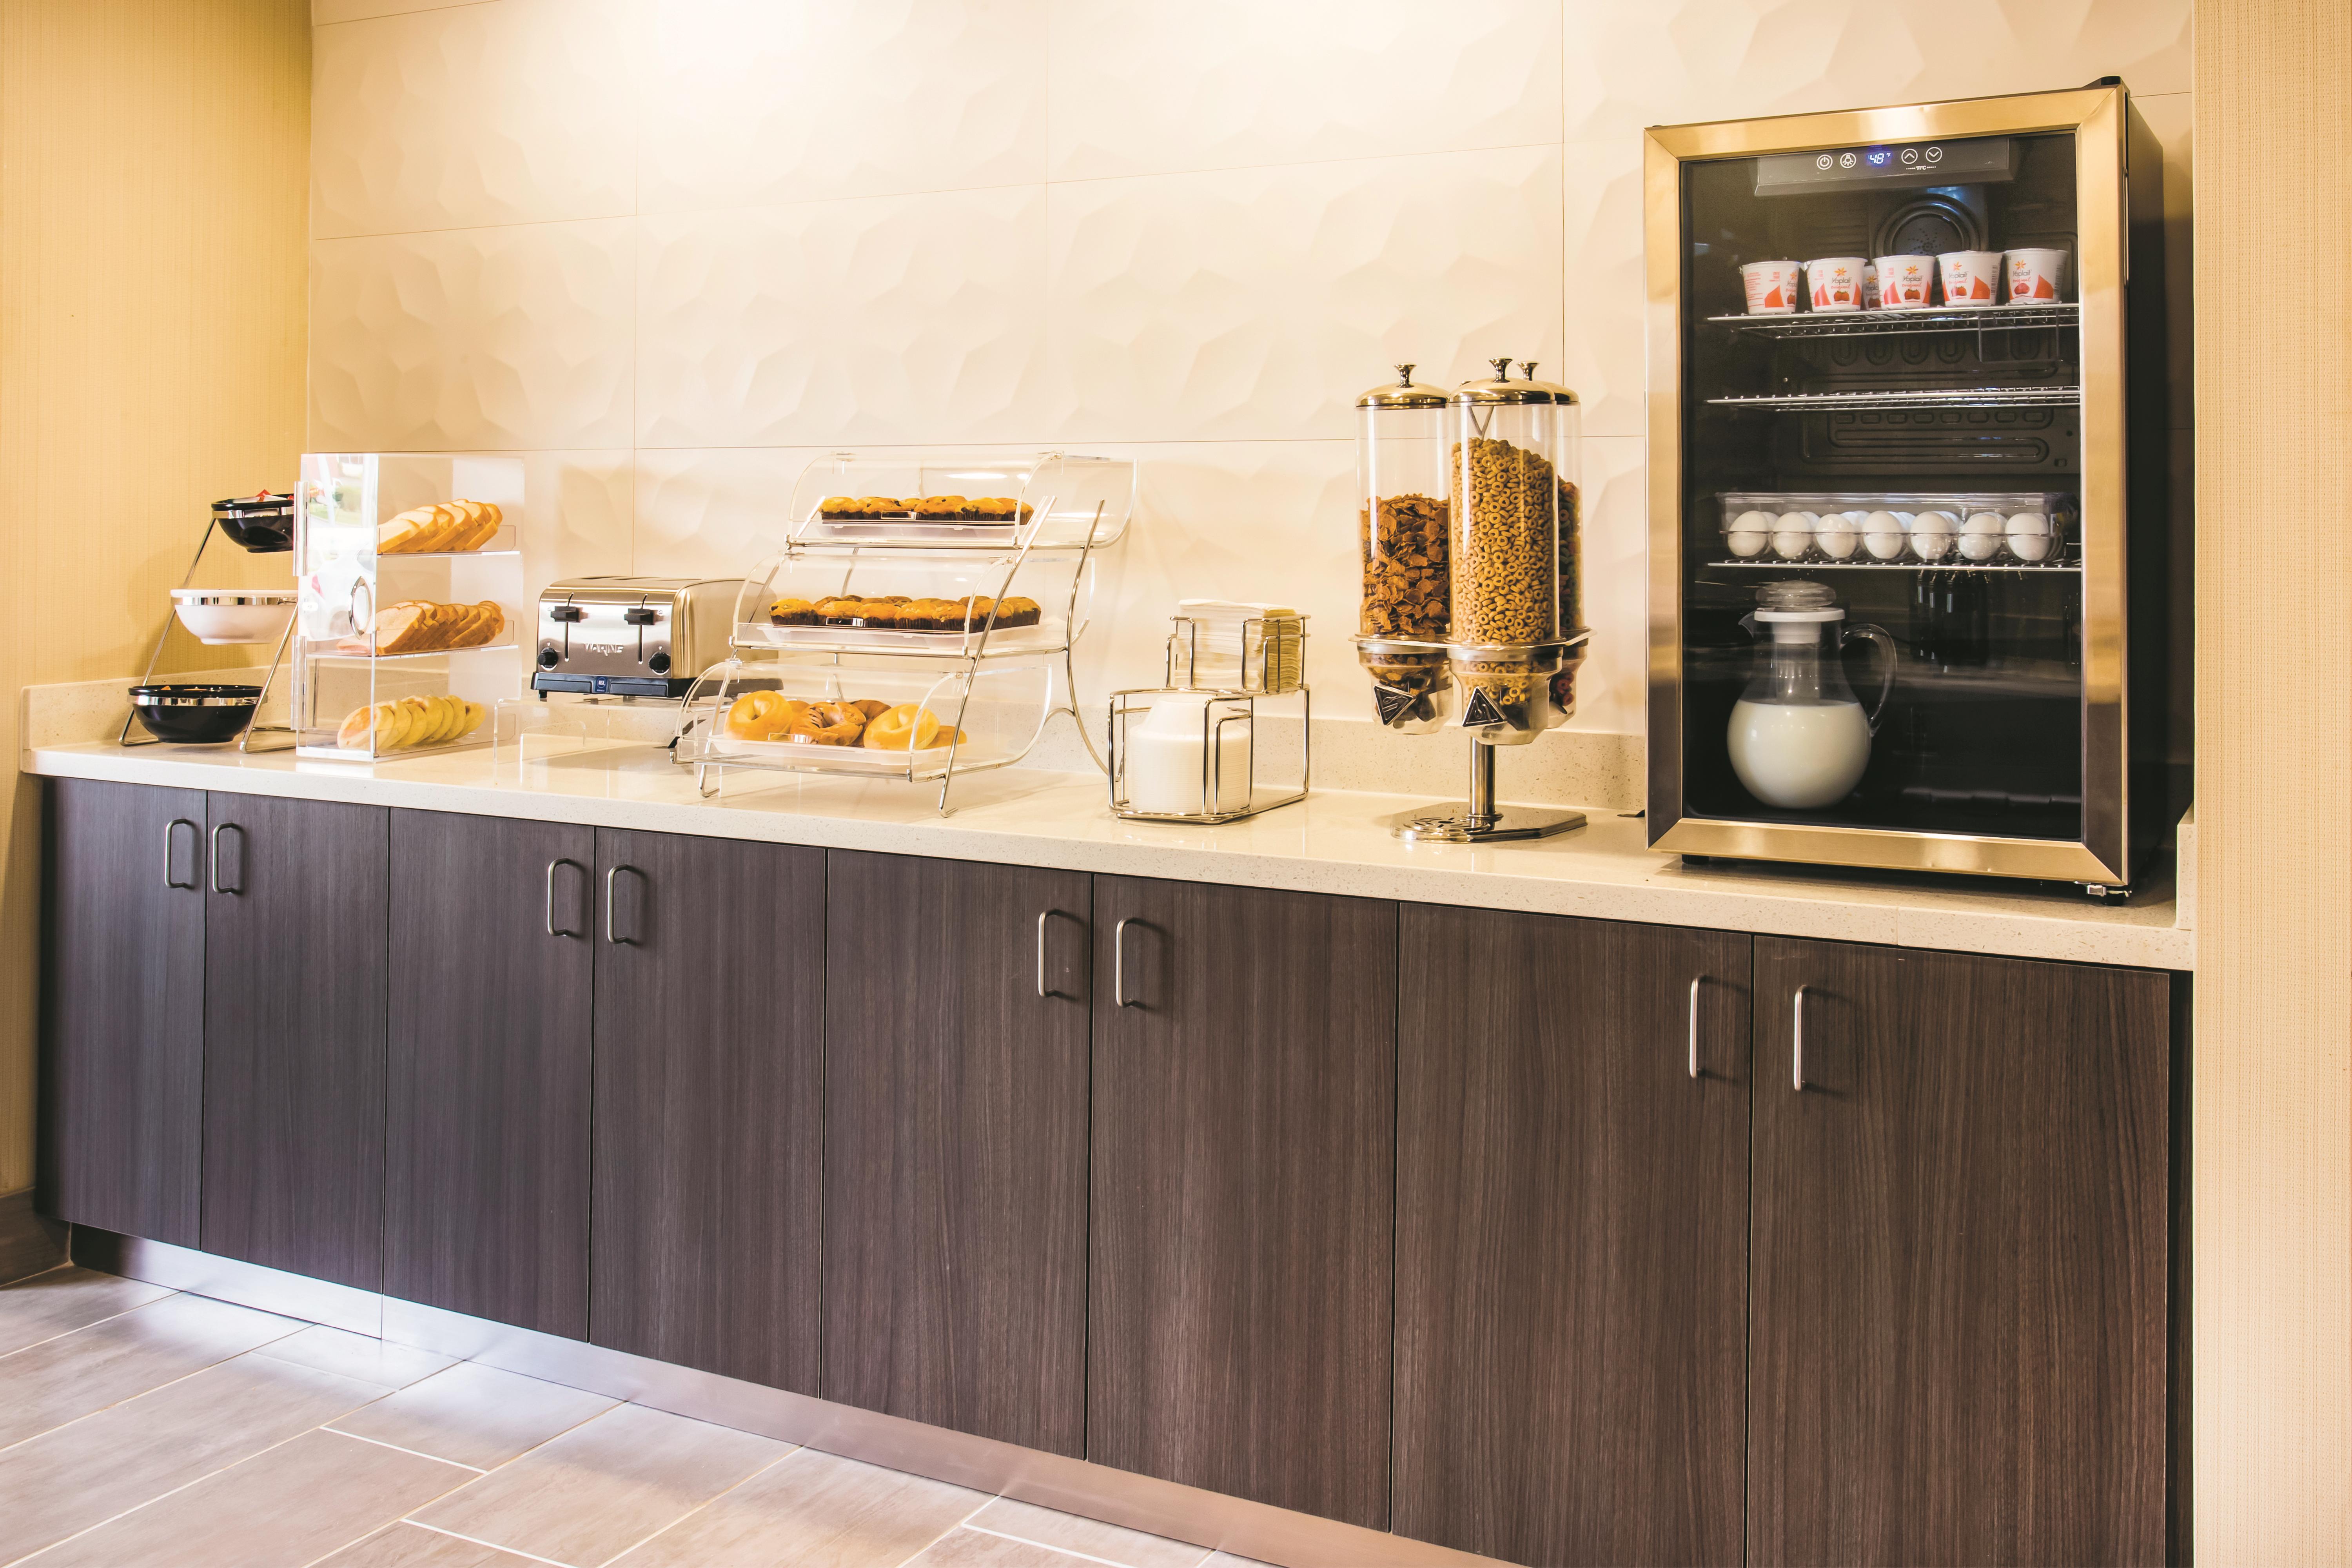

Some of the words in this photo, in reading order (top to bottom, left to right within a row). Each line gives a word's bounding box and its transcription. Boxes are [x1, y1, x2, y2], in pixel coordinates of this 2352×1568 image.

[1949, 271, 1967, 280] Yoplait
[2013, 270, 2031, 278] Yoplait
[1831, 277, 1851, 286] Yoplait
